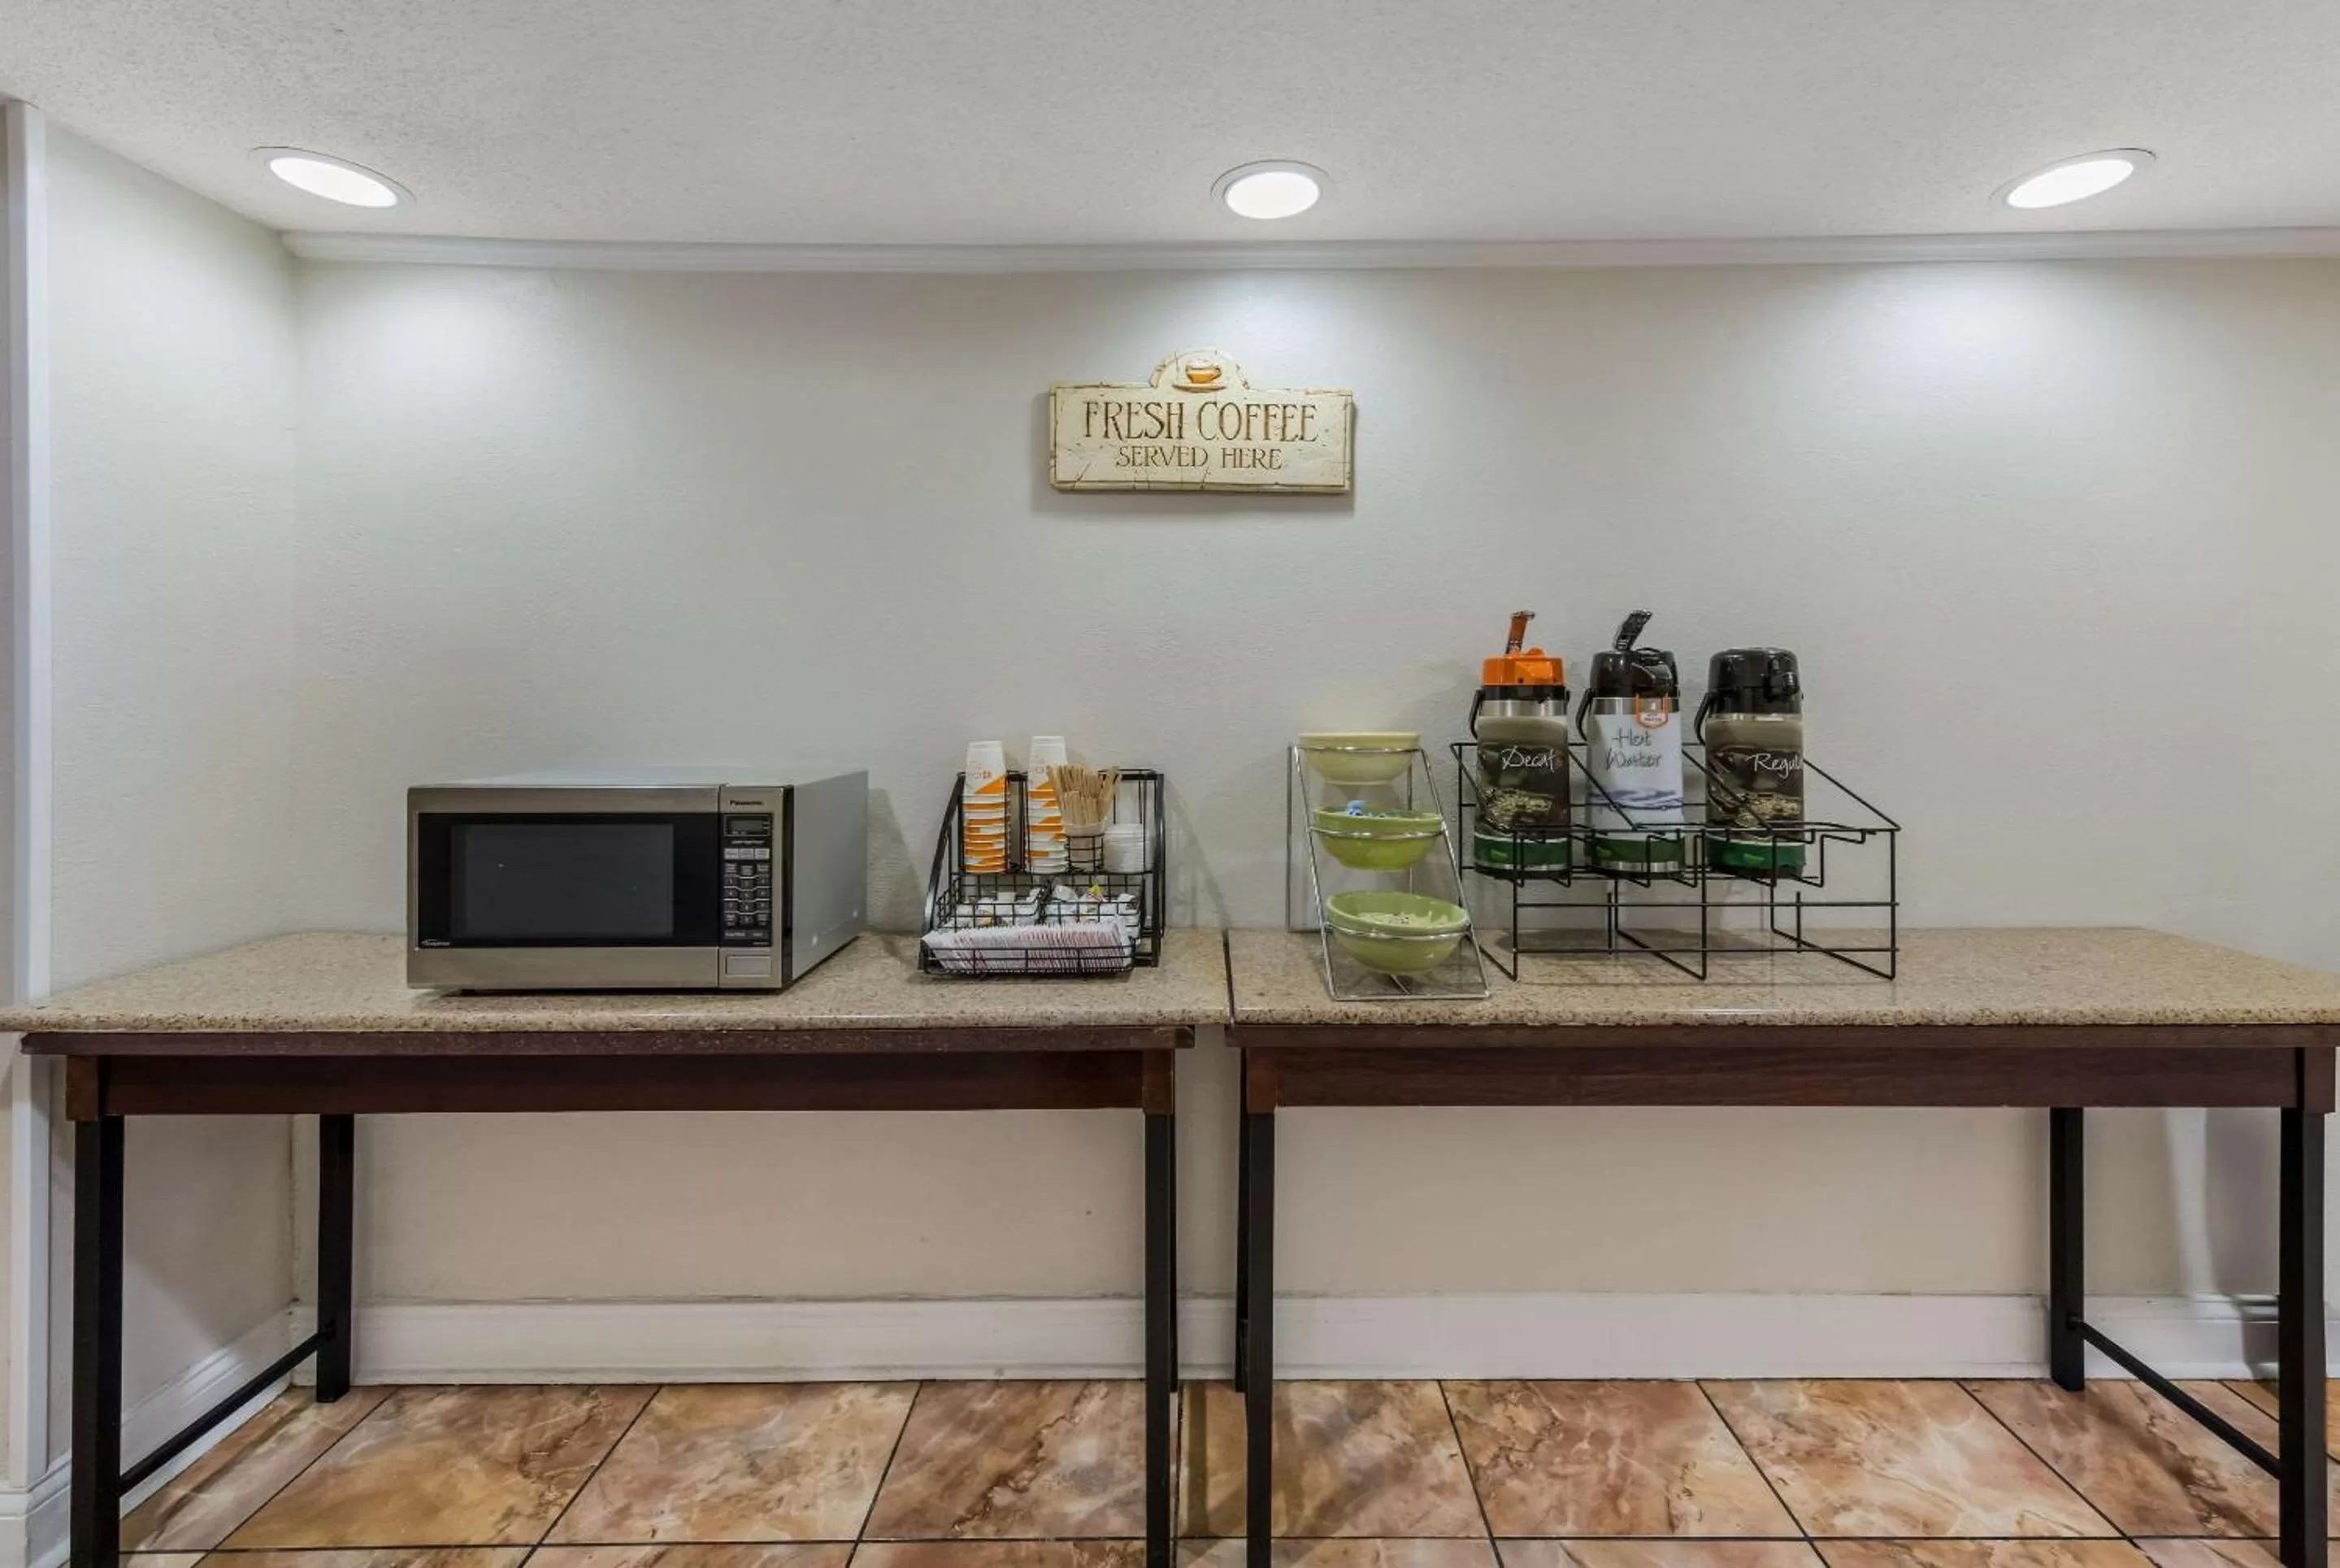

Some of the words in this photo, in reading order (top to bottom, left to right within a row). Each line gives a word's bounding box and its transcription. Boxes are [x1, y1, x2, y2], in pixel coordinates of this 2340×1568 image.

[1083, 401, 1184, 441] FRESH
[1197, 401, 1319, 442] COFFEE
[1116, 445, 1209, 467] SERVED
[1221, 448, 1283, 470] HERE
[1612, 728, 1652, 749] Hot
[1501, 745, 1556, 774] Decaf
[1605, 747, 1662, 771] Water
